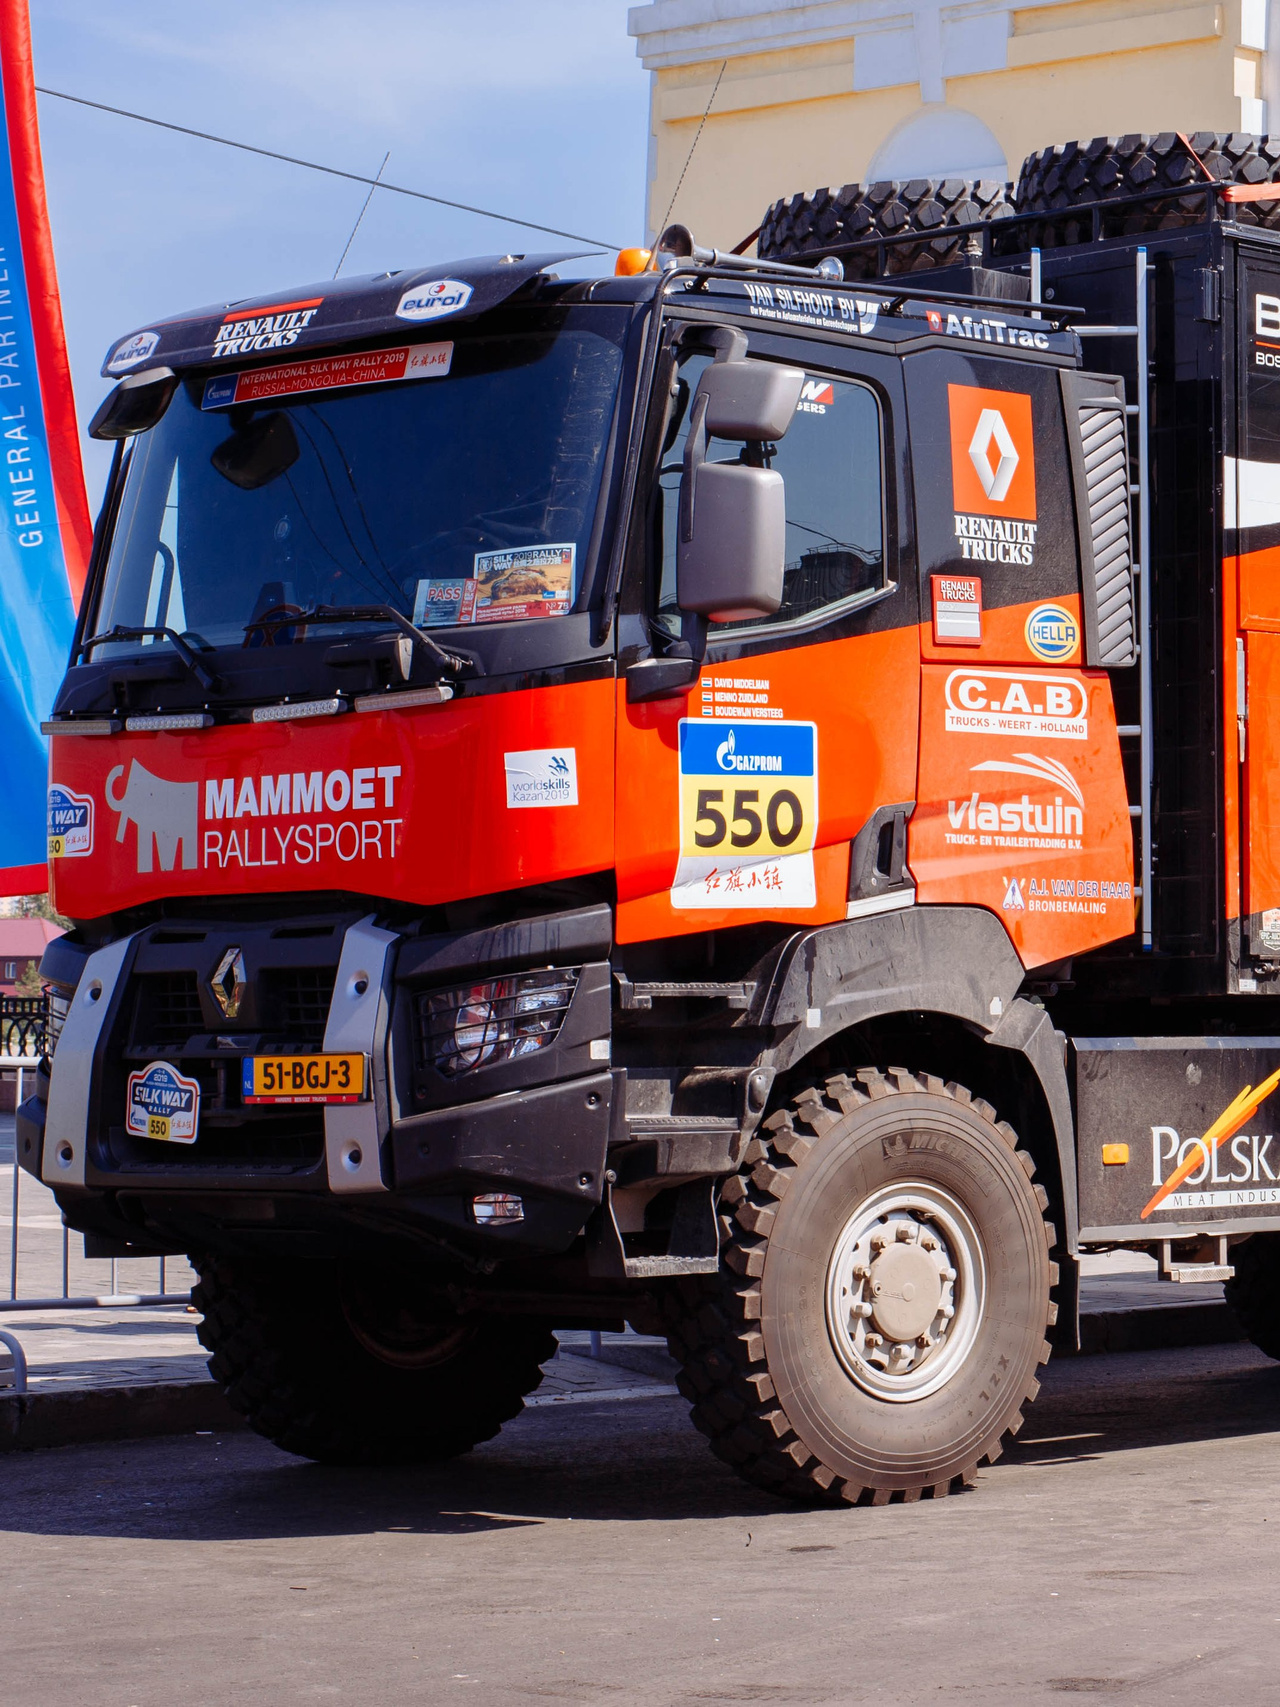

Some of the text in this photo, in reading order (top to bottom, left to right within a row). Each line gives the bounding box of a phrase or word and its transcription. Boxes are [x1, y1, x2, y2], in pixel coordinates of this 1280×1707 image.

[403, 292, 465, 310] eurol
[744, 283, 855, 320] VAN SILFHOUT BV
[214, 309, 317, 342] RENAULT
[946, 314, 1050, 349] AfriTrac
[211, 329, 302, 357] TRUCKS
[114, 340, 153, 364] eurol
[241, 352, 405, 386] INTERNATIONAL SILK WAY RALLY 2019
[2, 405, 43, 548] GENERAL
[954, 514, 1037, 545] RENAULT
[493, 554, 513, 564] SILK
[959, 537, 1034, 565] TRUCKS
[494, 561, 512, 571] WAY
[427, 587, 461, 601] PASS
[941, 580, 975, 592] RENAULT
[941, 590, 976, 601] TRUCKS
[1033, 625, 1076, 642] HELLA
[714, 678, 770, 690] DAVID MIDDELMAN
[714, 692, 768, 704] MENNO ZUIDLAND
[958, 679, 1073, 715] C.A.B
[715, 706, 784, 718] BOUDEWIJN VERSTEEG
[950, 715, 1085, 734] TRUCKS WEERT HOLLAND
[736, 755, 782, 771] GAZPROM
[205, 765, 401, 820] MAMMOET
[512, 778, 571, 792] worldskills
[513, 789, 569, 802] Kazan 2019
[55, 808, 85, 825] WAY
[694, 789, 803, 848] 550
[948, 792, 1083, 835] vlastuin
[204, 819, 403, 869] RALLYSPORT
[979, 836, 991, 846] EN
[993, 836, 1066, 849] TRAILERTRADING
[1068, 839, 1083, 850] B.V.
[1029, 878, 1131, 899] A.J. VAN DER HAAR
[1028, 900, 1106, 914] BRONBEMALING
[263, 1060, 350, 1090] 51-BGJ-3
[244, 1081, 252, 1089] NL
[134, 1086, 190, 1108] SILK WAY
[148, 1106, 171, 1114] RALLY
[150, 1119, 166, 1135] 550
[1173, 1194, 1216, 1206] MEAT
